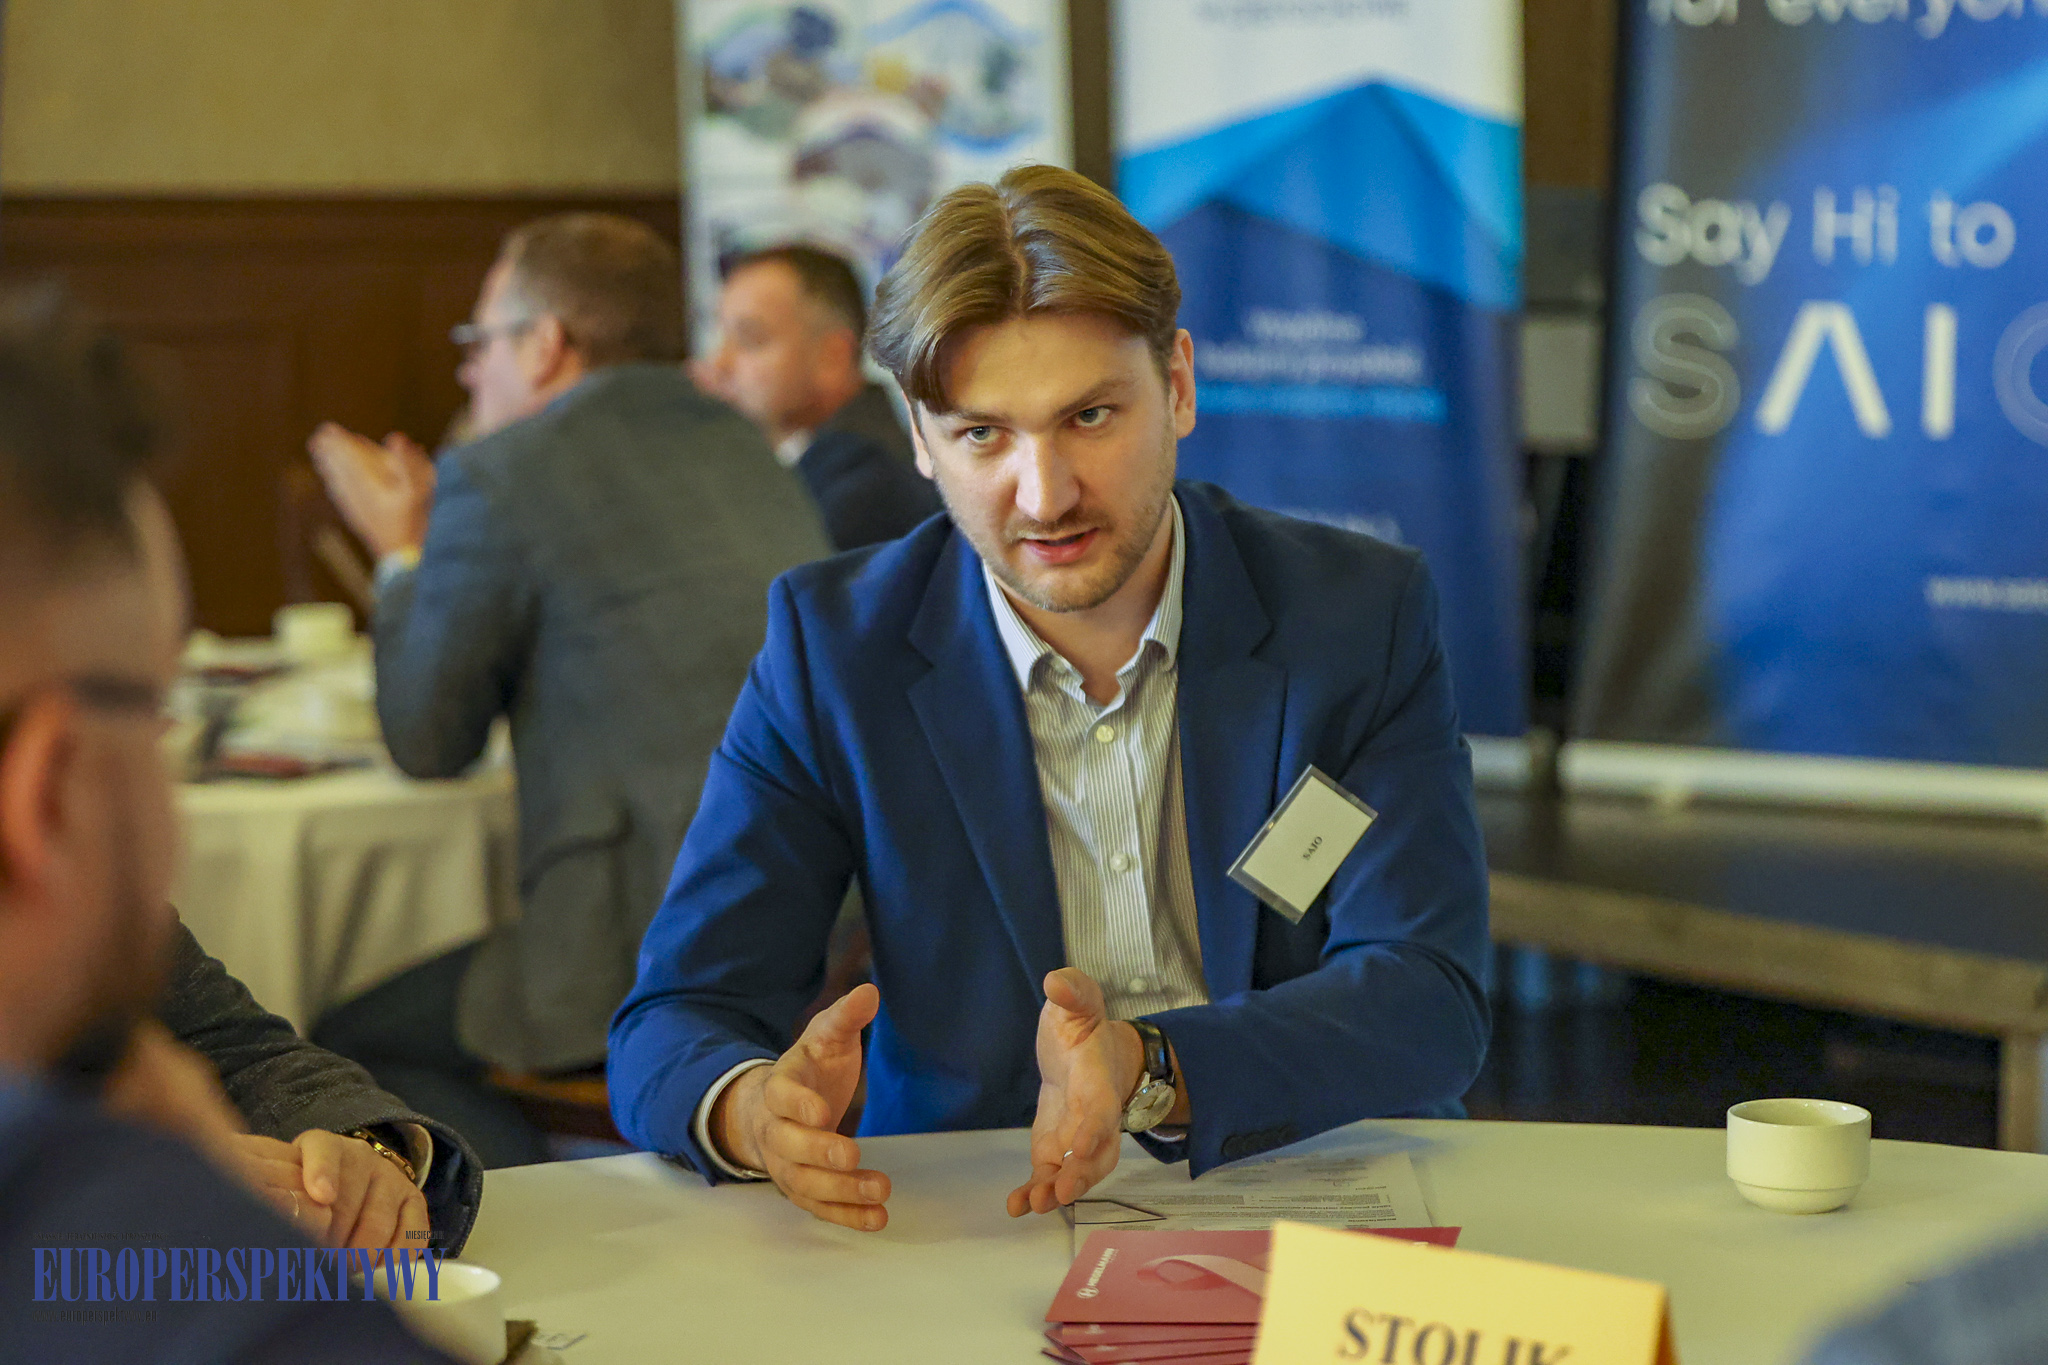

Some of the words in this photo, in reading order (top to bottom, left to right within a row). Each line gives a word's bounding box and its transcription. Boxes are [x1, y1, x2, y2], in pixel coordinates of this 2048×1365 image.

[1635, 183, 1791, 285] Say
[1812, 185, 1899, 266] Hi
[1931, 190, 2016, 268] to
